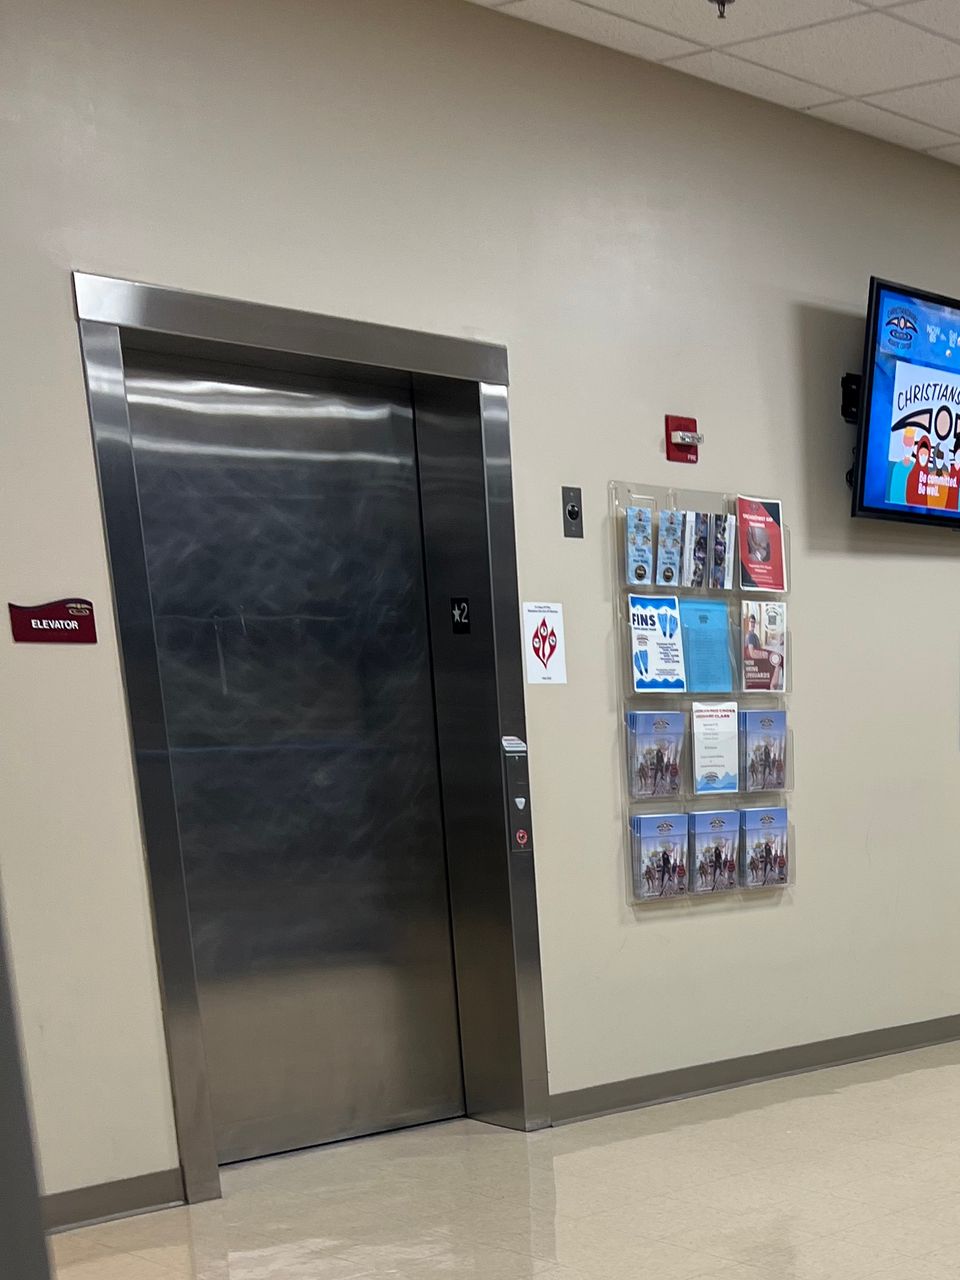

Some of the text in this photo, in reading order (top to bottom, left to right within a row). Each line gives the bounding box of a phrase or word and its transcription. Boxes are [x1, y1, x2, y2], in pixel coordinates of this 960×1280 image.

[919, 471, 958, 488] Be committed.
[917, 482, 940, 497] Be well.
[460, 602, 469, 623] 2
[632, 613, 656, 627] FINS
[31, 619, 79, 630] ELEVATOR
